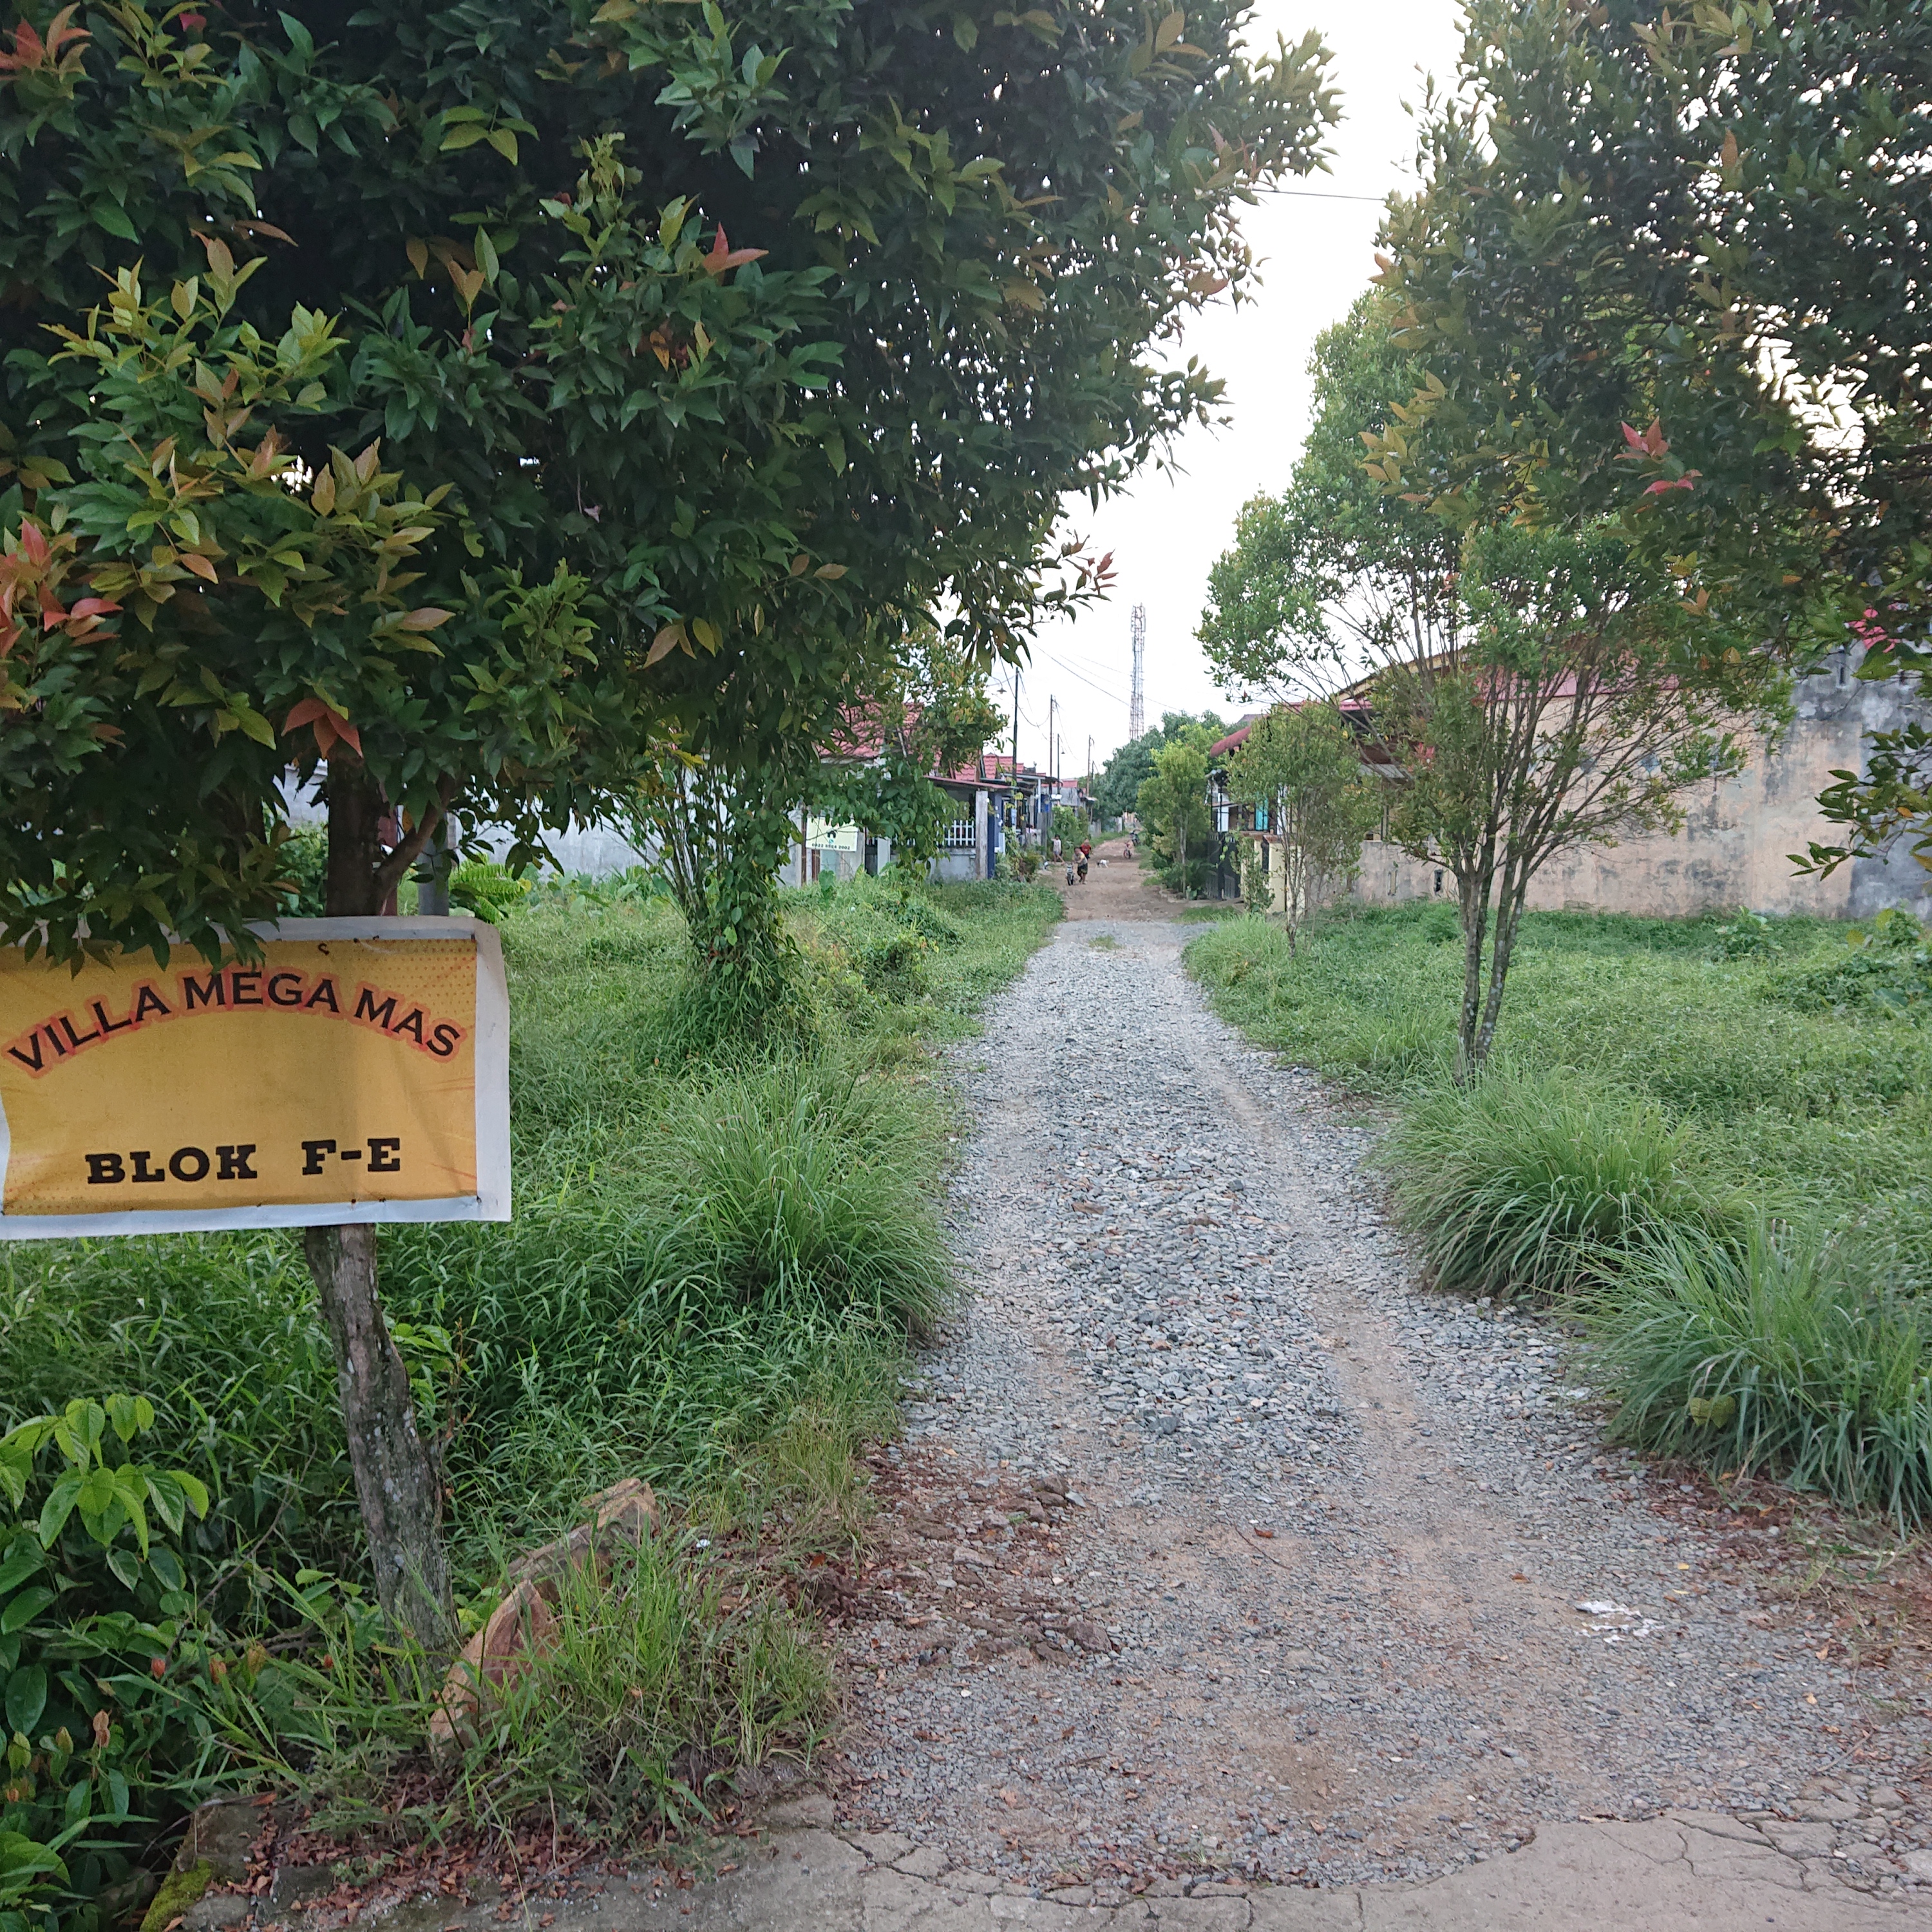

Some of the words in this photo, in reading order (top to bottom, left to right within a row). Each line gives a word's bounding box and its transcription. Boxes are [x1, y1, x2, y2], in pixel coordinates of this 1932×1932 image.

[7, 985, 172, 1072] VILLA
[183, 972, 340, 1012] MEGA
[354, 988, 460, 1056] MAS
[85, 1144, 258, 1184] BLOK
[301, 1138, 400, 1175] F-E
